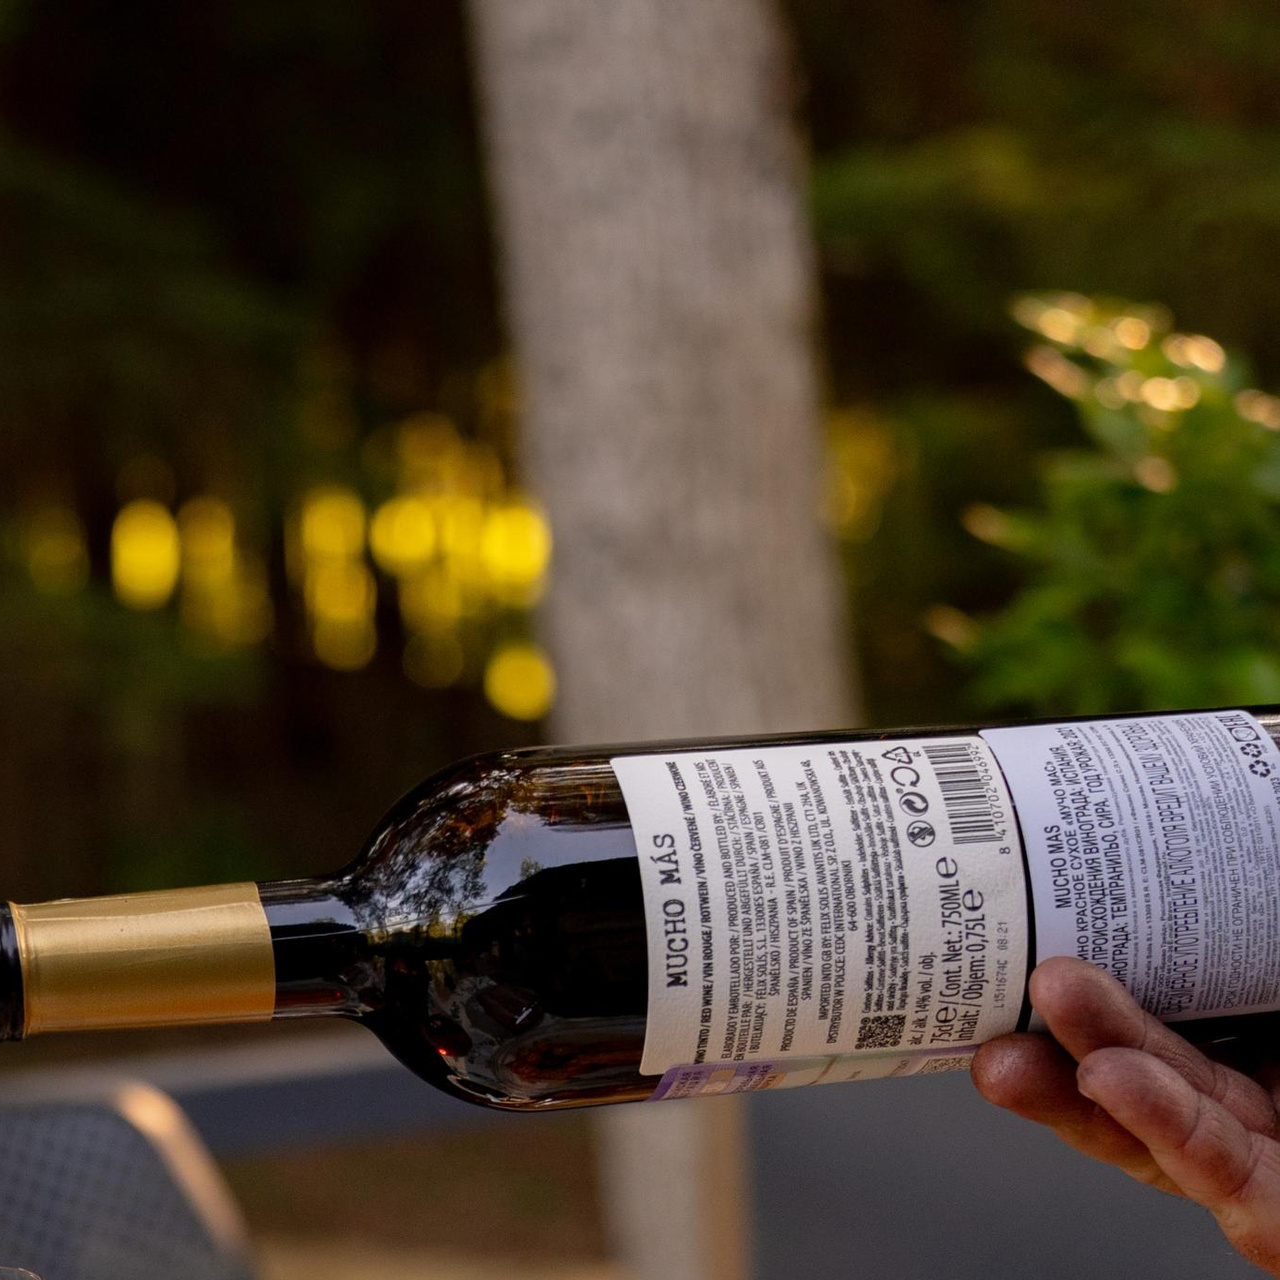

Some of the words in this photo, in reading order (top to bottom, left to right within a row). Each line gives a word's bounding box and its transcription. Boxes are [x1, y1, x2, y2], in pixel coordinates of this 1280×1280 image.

[752, 759, 766, 770] AUS
[1050, 745, 1081, 785] ИСПАНИЯ.
[1067, 740, 1096, 773] УРОЖАЯ:
[1140, 753, 1173, 786] ВАШЕМУ
[1191, 745, 1217, 779] УСЛОВИЙ
[666, 762, 686, 791] CZERWONE
[705, 759, 726, 789] PRODUCENT
[724, 766, 741, 789] SPANIEN
[758, 771, 776, 799] PRODUKT
[796, 782, 807, 791] UK
[1044, 761, 1062, 786] МАС»
[1084, 774, 1105, 793] ГОД
[678, 791, 692, 812] WINO
[700, 779, 719, 807] ÉLABORÉ
[805, 769, 827, 814] KOWANOWSKA
[1152, 787, 1192, 823] ВРЕДИТ
[713, 814, 724, 824] BY:
[734, 795, 751, 825] ESPAGNE
[783, 803, 800, 838] HISZPANII
[804, 809, 816, 822] CT1
[820, 816, 831, 828] UL.
[984, 787, 1007, 837] 410702
[1053, 789, 1073, 826] «МУЧО
[1070, 788, 1099, 855] ВИНОГРАДА:
[1094, 798, 1115, 829] СИРА.
[1210, 780, 1234, 844] СОБЛЮДЕНИИ
[684, 817, 701, 852] ČERVENÉ
[715, 825, 731, 860] BOTTLED
[744, 832, 757, 855] SPAIN
[808, 823, 820, 838] LTD,
[811, 839, 822, 851] UK
[1044, 825, 1064, 854] MAS
[652, 834, 682, 885] MÁS
[693, 852, 705, 875] VÍNO
[732, 837, 746, 867] DURCH:
[758, 835, 773, 871] CLM-081
[779, 847, 793, 882] PRODUIT
[793, 846, 805, 870] WINO
[827, 855, 838, 866] SP.
[999, 846, 1011, 855] 8
[1064, 830, 1082, 870] СУХОЕ
[1162, 824, 1193, 875] АЛКОГОЛЯ
[1225, 846, 1238, 866] ПРИ
[722, 861, 733, 879] AND
[748, 862, 763, 895] ESPAÑA
[764, 872, 776, 888] R.E.
[813, 852, 827, 885] AVANTIS
[841, 860, 855, 900] OBORNIKI
[1050, 858, 1072, 909] MUCHO
[1102, 831, 1127, 919] ТЕМПРАНИЛЬО,
[698, 881, 711, 922] ROTWEIN
[725, 881, 738, 927] PRODUCED
[736, 870, 751, 915] ABGEFÜLLT
[786, 890, 797, 915] SPAIN
[798, 877, 811, 925] ŠPANĚLSKA
[818, 887, 830, 911] SOLIS
[830, 868, 844, 932] INTERNATIONAL
[1072, 874, 1088, 932] КРАСНОЕ
[1229, 869, 1243, 926] ОГРАНИЧЕН
[753, 896, 766, 932] 13300ES
[768, 897, 780, 943] HISZPANIA
[787, 917, 798, 928] OF
[820, 912, 831, 934] FELIX
[846, 901, 858, 932] 64-600
[1085, 858, 1108, 960] ПРОИСХОЖДЕНИЯ
[1169, 879, 1199, 958] УПОТРЕБЛЕНИЕ
[742, 917, 753, 937] UND
[801, 927, 812, 937] ZE
[1232, 928, 1244, 942] НЕ
[664, 900, 688, 988] MUCHO
[702, 930, 713, 961] ROUGE
[729, 935, 740, 955] POR:
[756, 935, 767, 950] S.L.
[788, 930, 799, 969] PRODUCT
[801, 939, 813, 960] VÍNO
[821, 936, 832, 949] BY:
[821, 950, 832, 962] GB
[834, 934, 845, 955] CEDC
[941, 930, 963, 963] Net.:
[702, 962, 713, 980] VIN
[743, 939, 754, 992] HERGESTELLT
[755, 951, 768, 978] SOLÍS,
[768, 950, 781, 996] ŠPANĚLSKO
[821, 963, 832, 982] INTO
[834, 956, 846, 988] POLSCE:
[918, 952, 937, 970] obj.
[1228, 944, 1243, 989] ГОДНОСТИ
[729, 957, 740, 1014] EMBOTELLADO
[754, 979, 767, 1000] FÉLIX
[787, 976, 799, 1006] ESPAÑA
[801, 967, 812, 1000] SPANIEN
[917, 977, 933, 994] vol.
[939, 965, 962, 998] Cont.
[962, 955, 989, 1000] Objem:
[1165, 959, 1197, 1014] ЧРЕЗМЕРНОЕ
[702, 985, 713, 1007] WINE
[819, 983, 831, 1020] IMPORTED
[834, 989, 844, 998] W
[915, 995, 931, 1014] 14%
[1223, 990, 1237, 1009] СРОК
[701, 1008, 712, 1023] RED
[741, 1001, 753, 1018] PAR:
[786, 1007, 797, 1017] DE
[827, 998, 843, 1044] DYSTRYBUTOR
[697, 1028, 710, 1049] TINTO
[721, 1021, 737, 1059] ELABORADO
[736, 1019, 751, 1052] BOUTEILLE
[749, 1003, 767, 1050] BUTELKUJĄCY:
[780, 1018, 795, 1051] PRODUCTO
[953, 1010, 979, 1042] Inhalt:
[693, 1049, 706, 1065] VINO
[733, 1053, 744, 1061] EN
